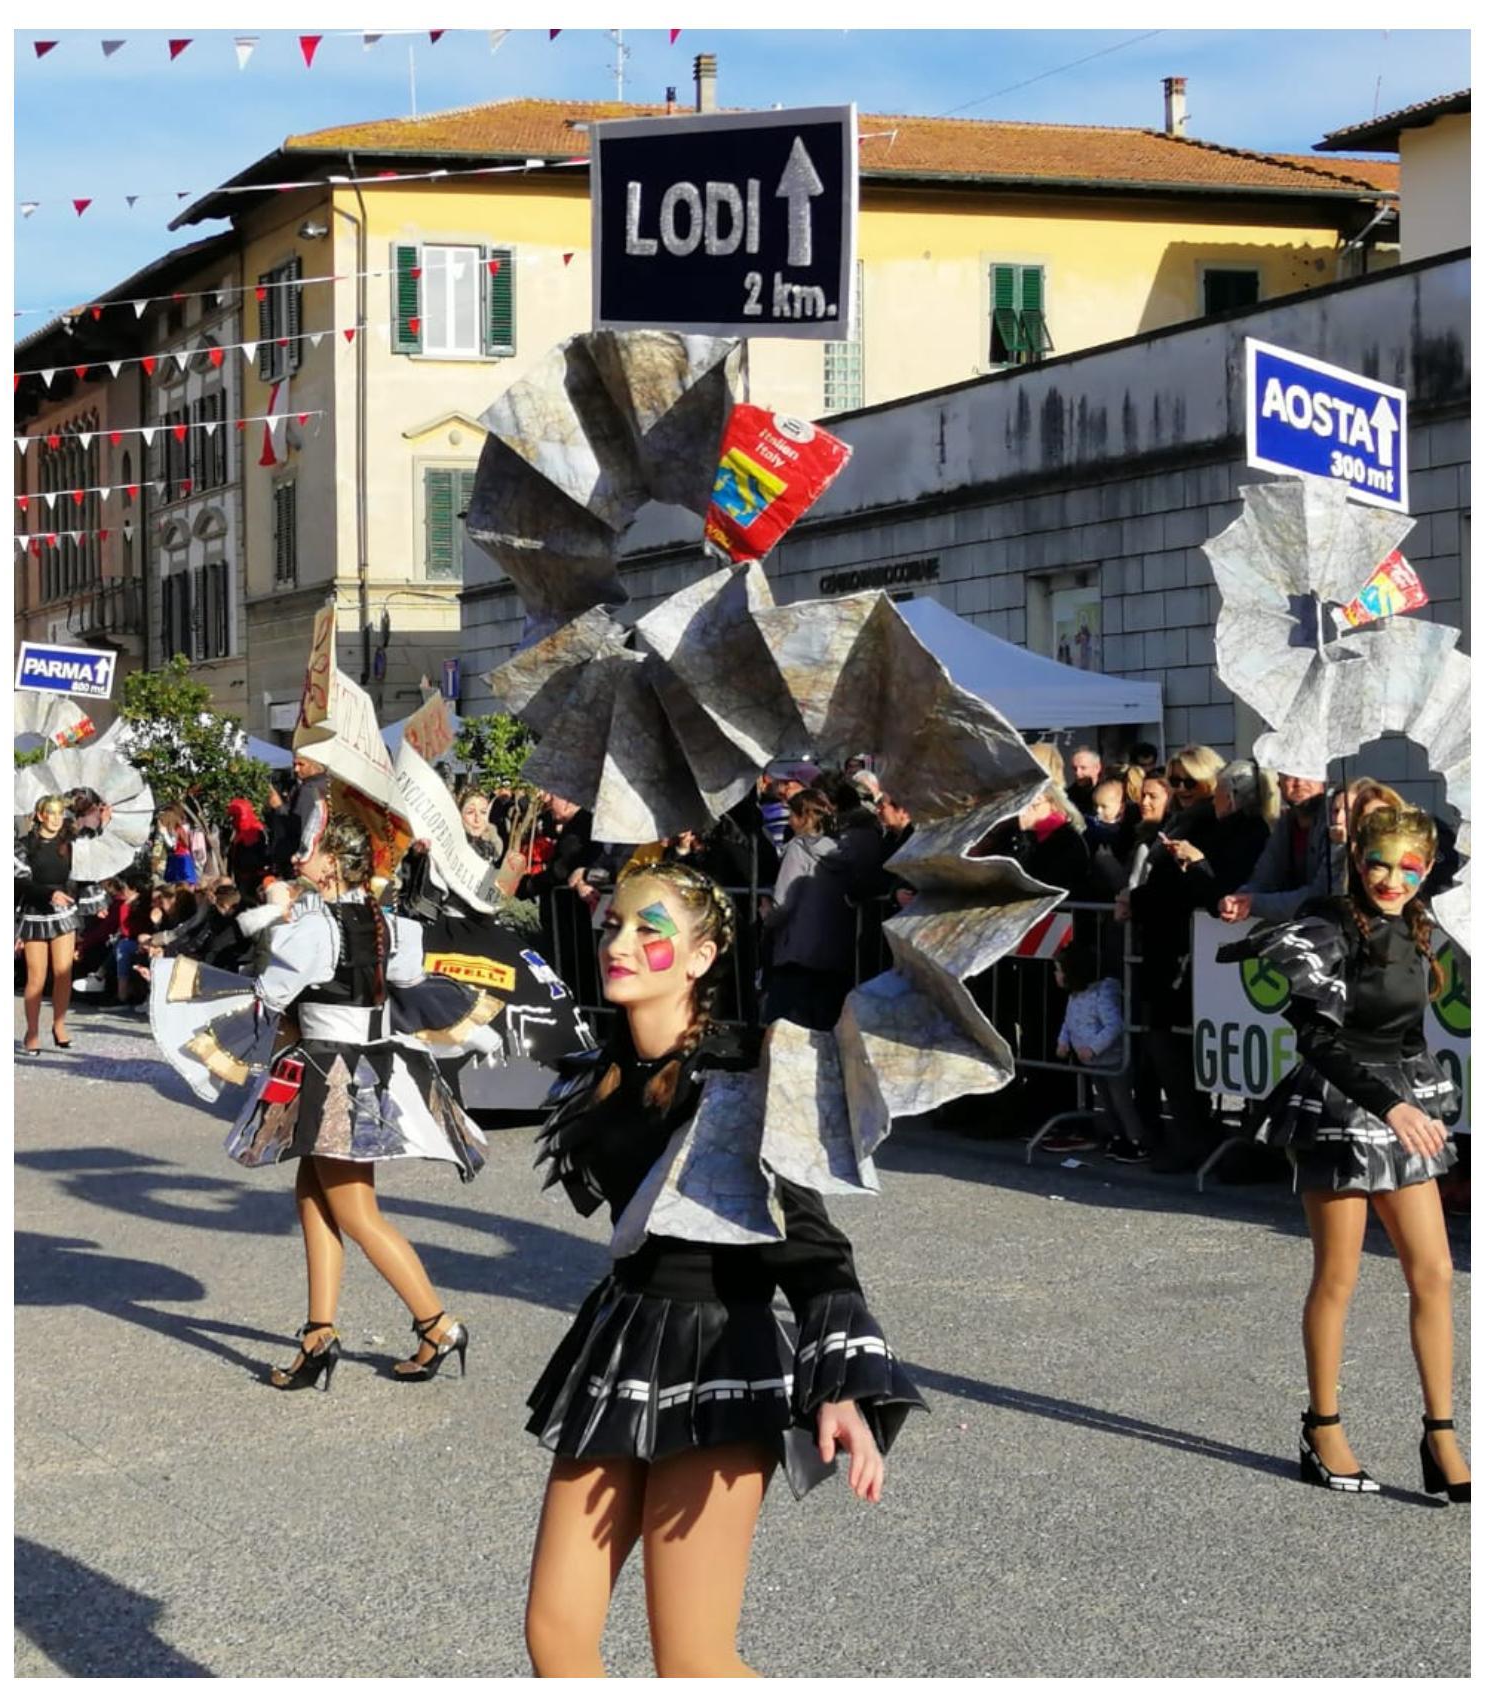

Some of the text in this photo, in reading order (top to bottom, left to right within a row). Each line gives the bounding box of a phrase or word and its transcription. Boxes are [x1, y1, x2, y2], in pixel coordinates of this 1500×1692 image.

[626, 178, 761, 257] LODI
[743, 271, 838, 319] 2 km.
[1261, 377, 1375, 453] AOSTA
[1330, 450, 1395, 494] 300 mt
[23, 657, 94, 682] PARMA
[1195, 1018, 1303, 1096] GEOF
